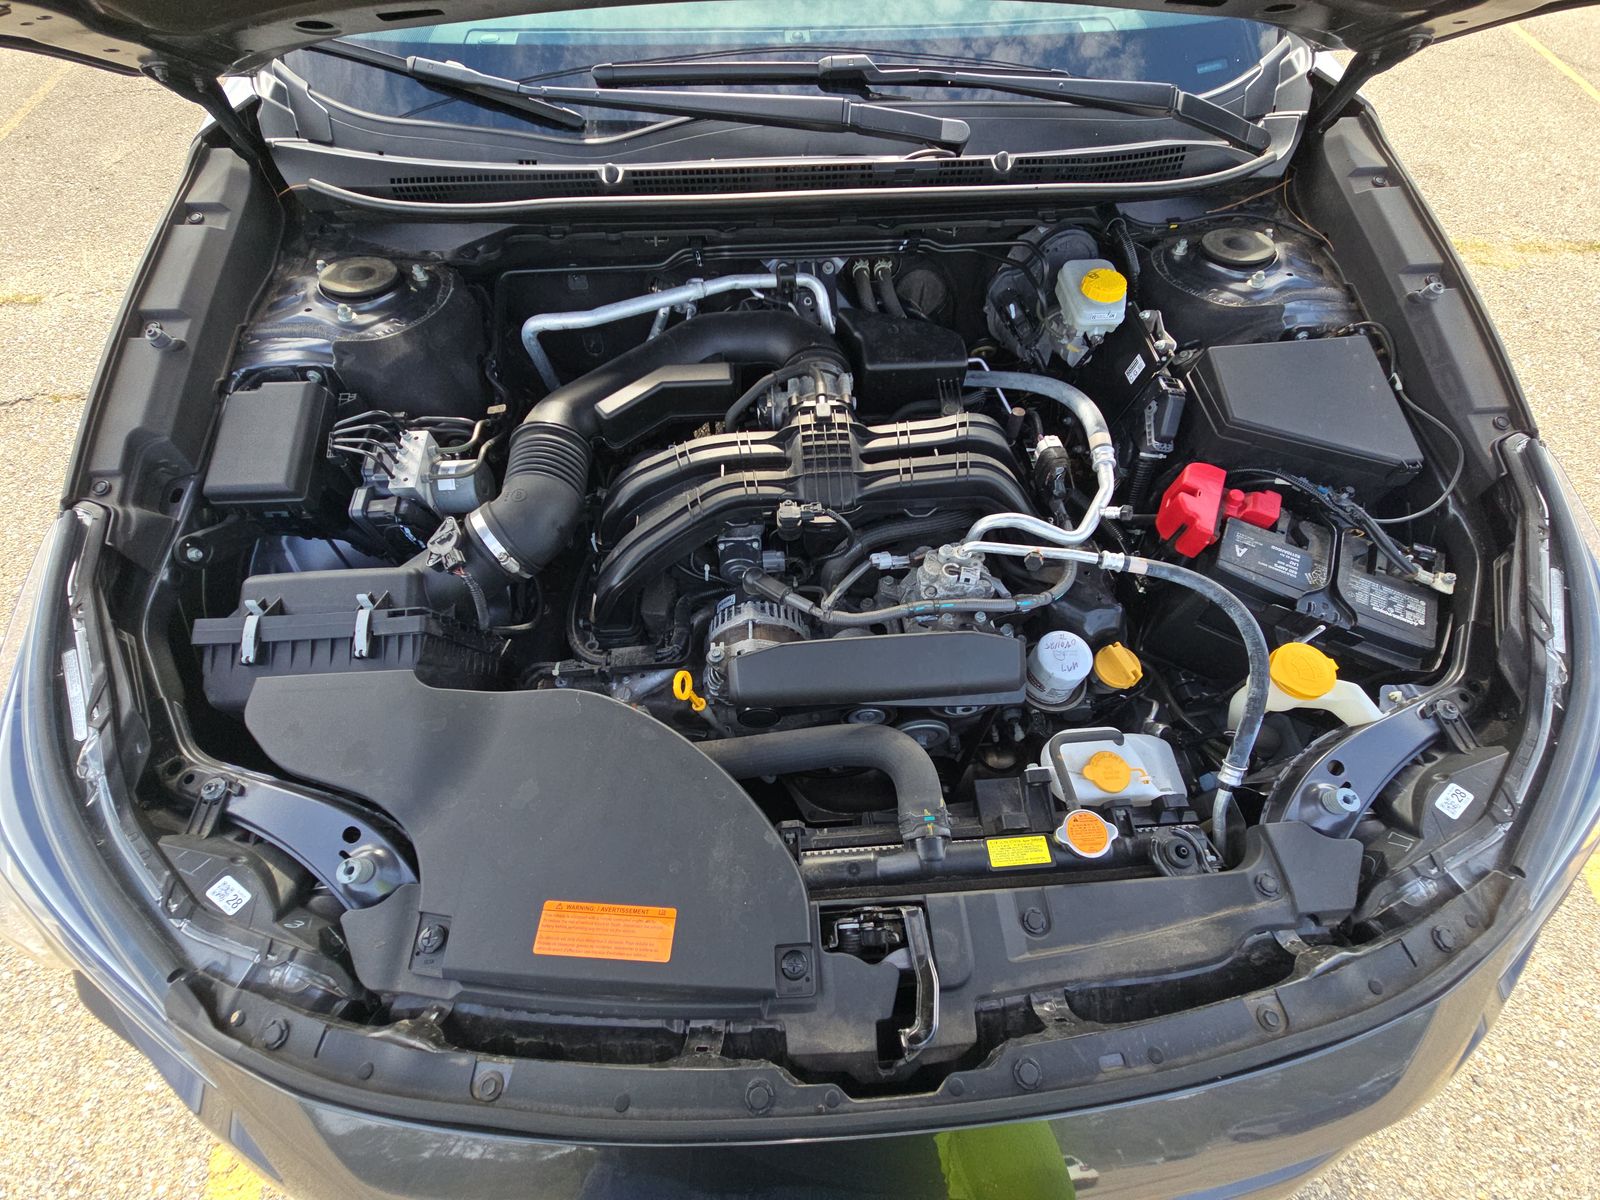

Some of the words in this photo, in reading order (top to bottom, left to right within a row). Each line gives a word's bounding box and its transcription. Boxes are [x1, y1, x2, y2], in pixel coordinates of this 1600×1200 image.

[1451, 788, 1467, 803] 28
[226, 893, 243, 909] 28
[600, 906, 649, 914] AVERTISSEMENT
